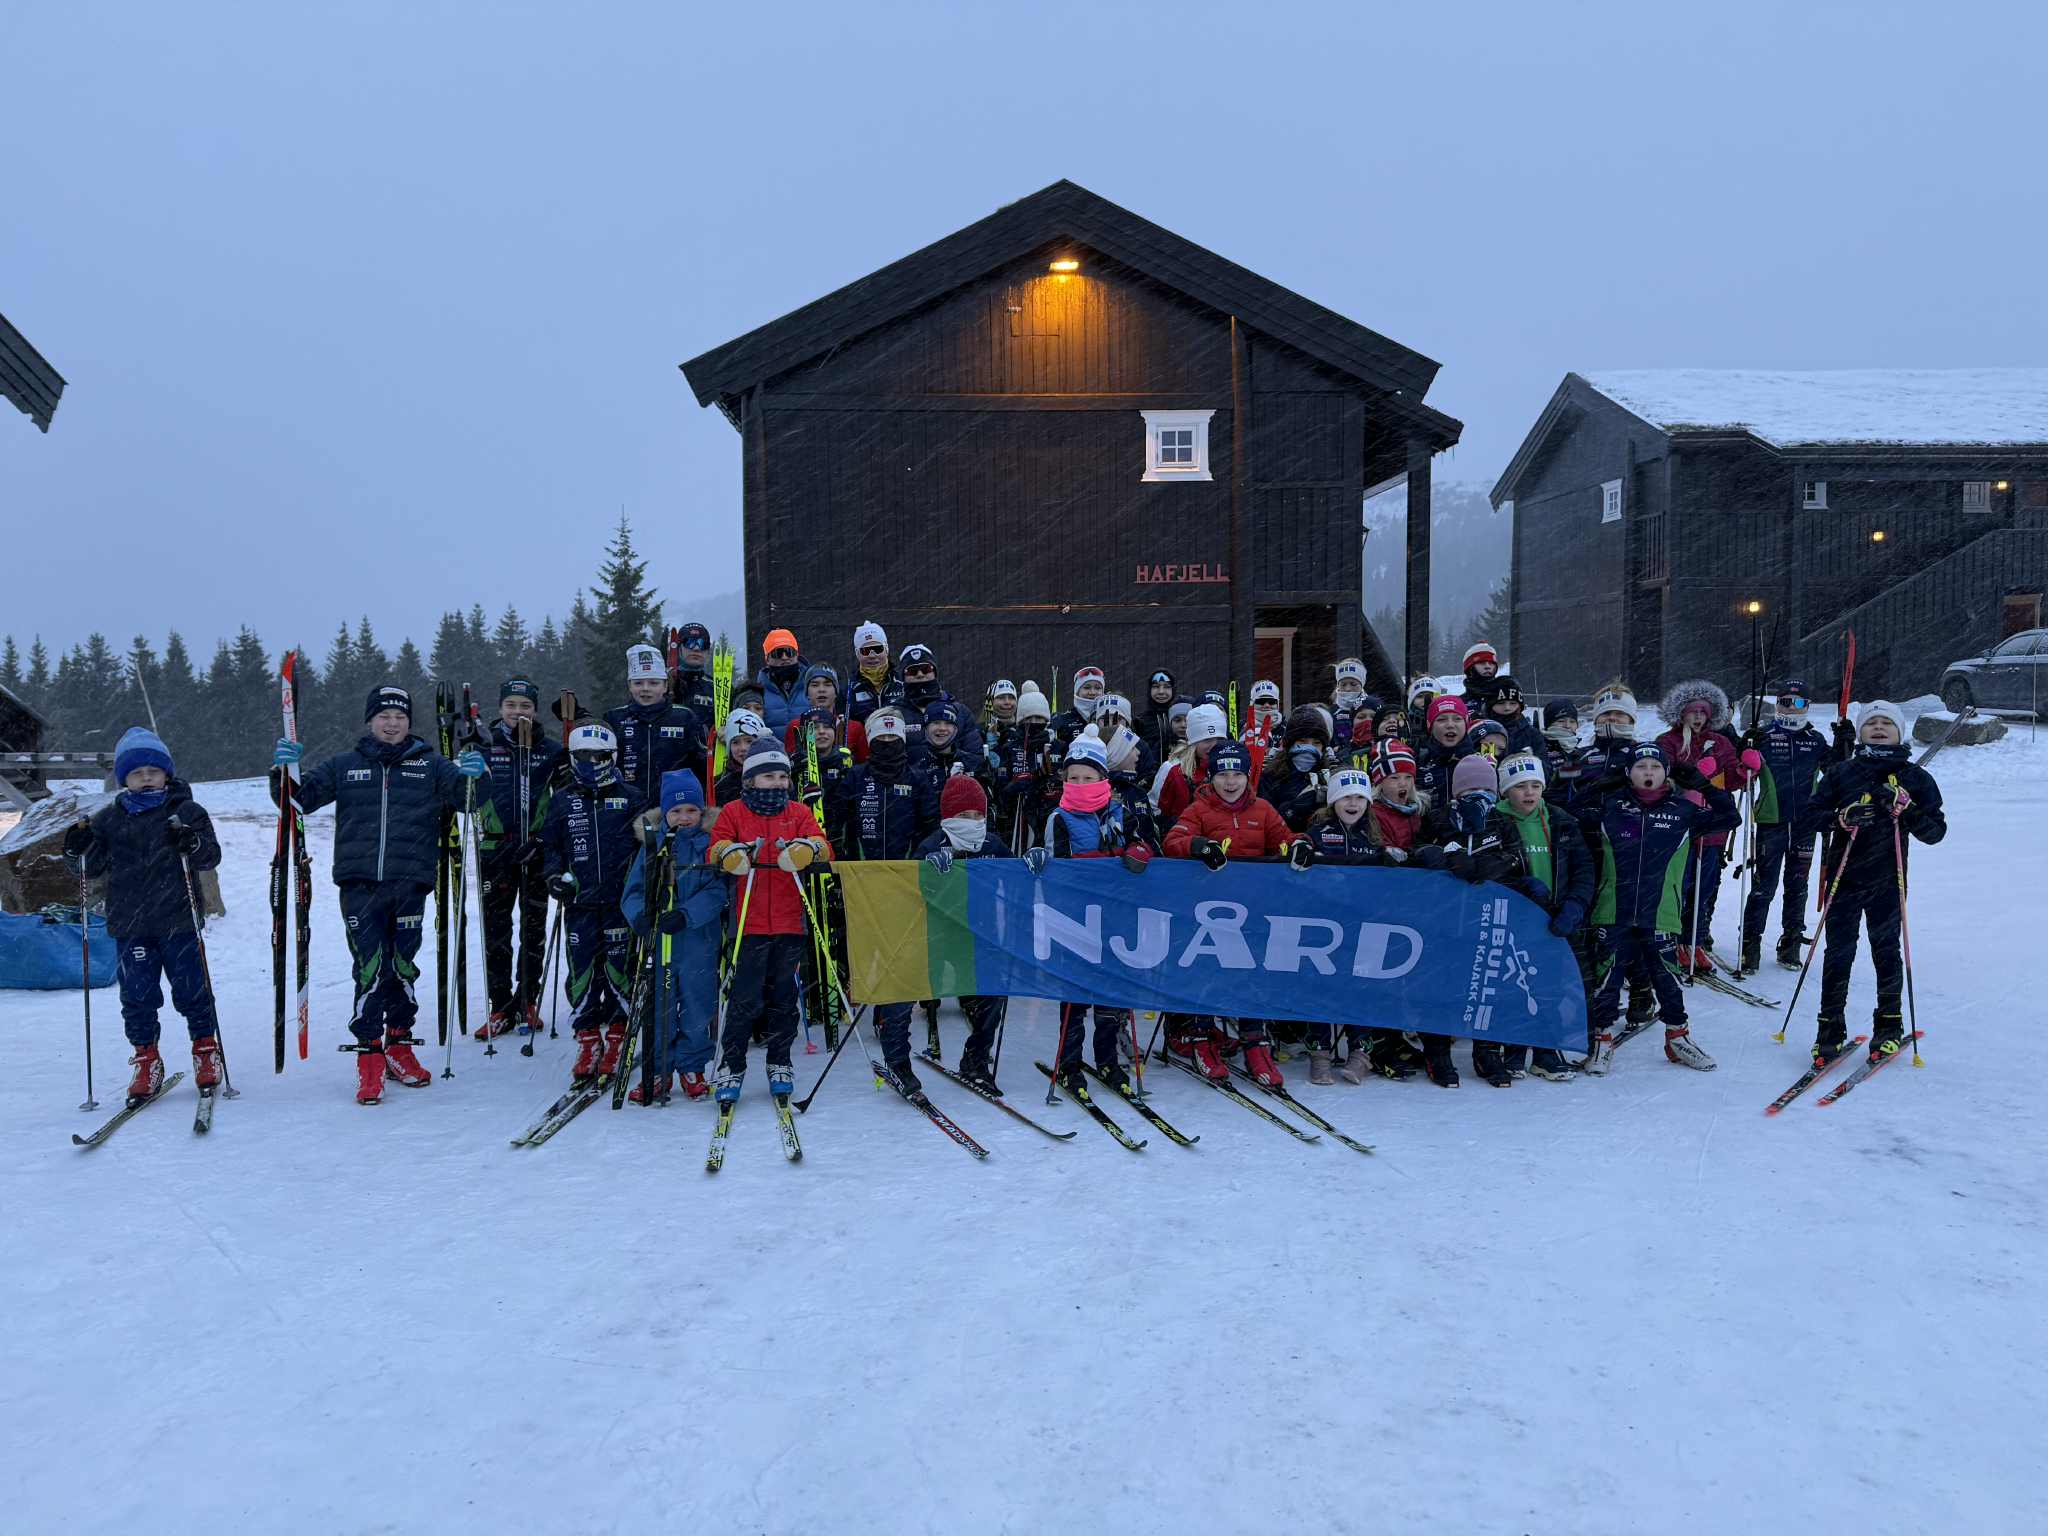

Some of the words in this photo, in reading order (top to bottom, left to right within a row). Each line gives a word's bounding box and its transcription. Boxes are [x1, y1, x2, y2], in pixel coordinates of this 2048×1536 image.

[1136, 563, 1230, 582] HAFJELL
[1480, 903, 1492, 927] SKI
[1033, 900, 1424, 980] NJÅRD
[1479, 931, 1488, 941] &
[1467, 945, 1486, 1002] KAJAKK
[1481, 928, 1506, 1003] BULL
[1463, 1005, 1475, 1022] AS
[935, 1116, 986, 1157] MADSHUS
